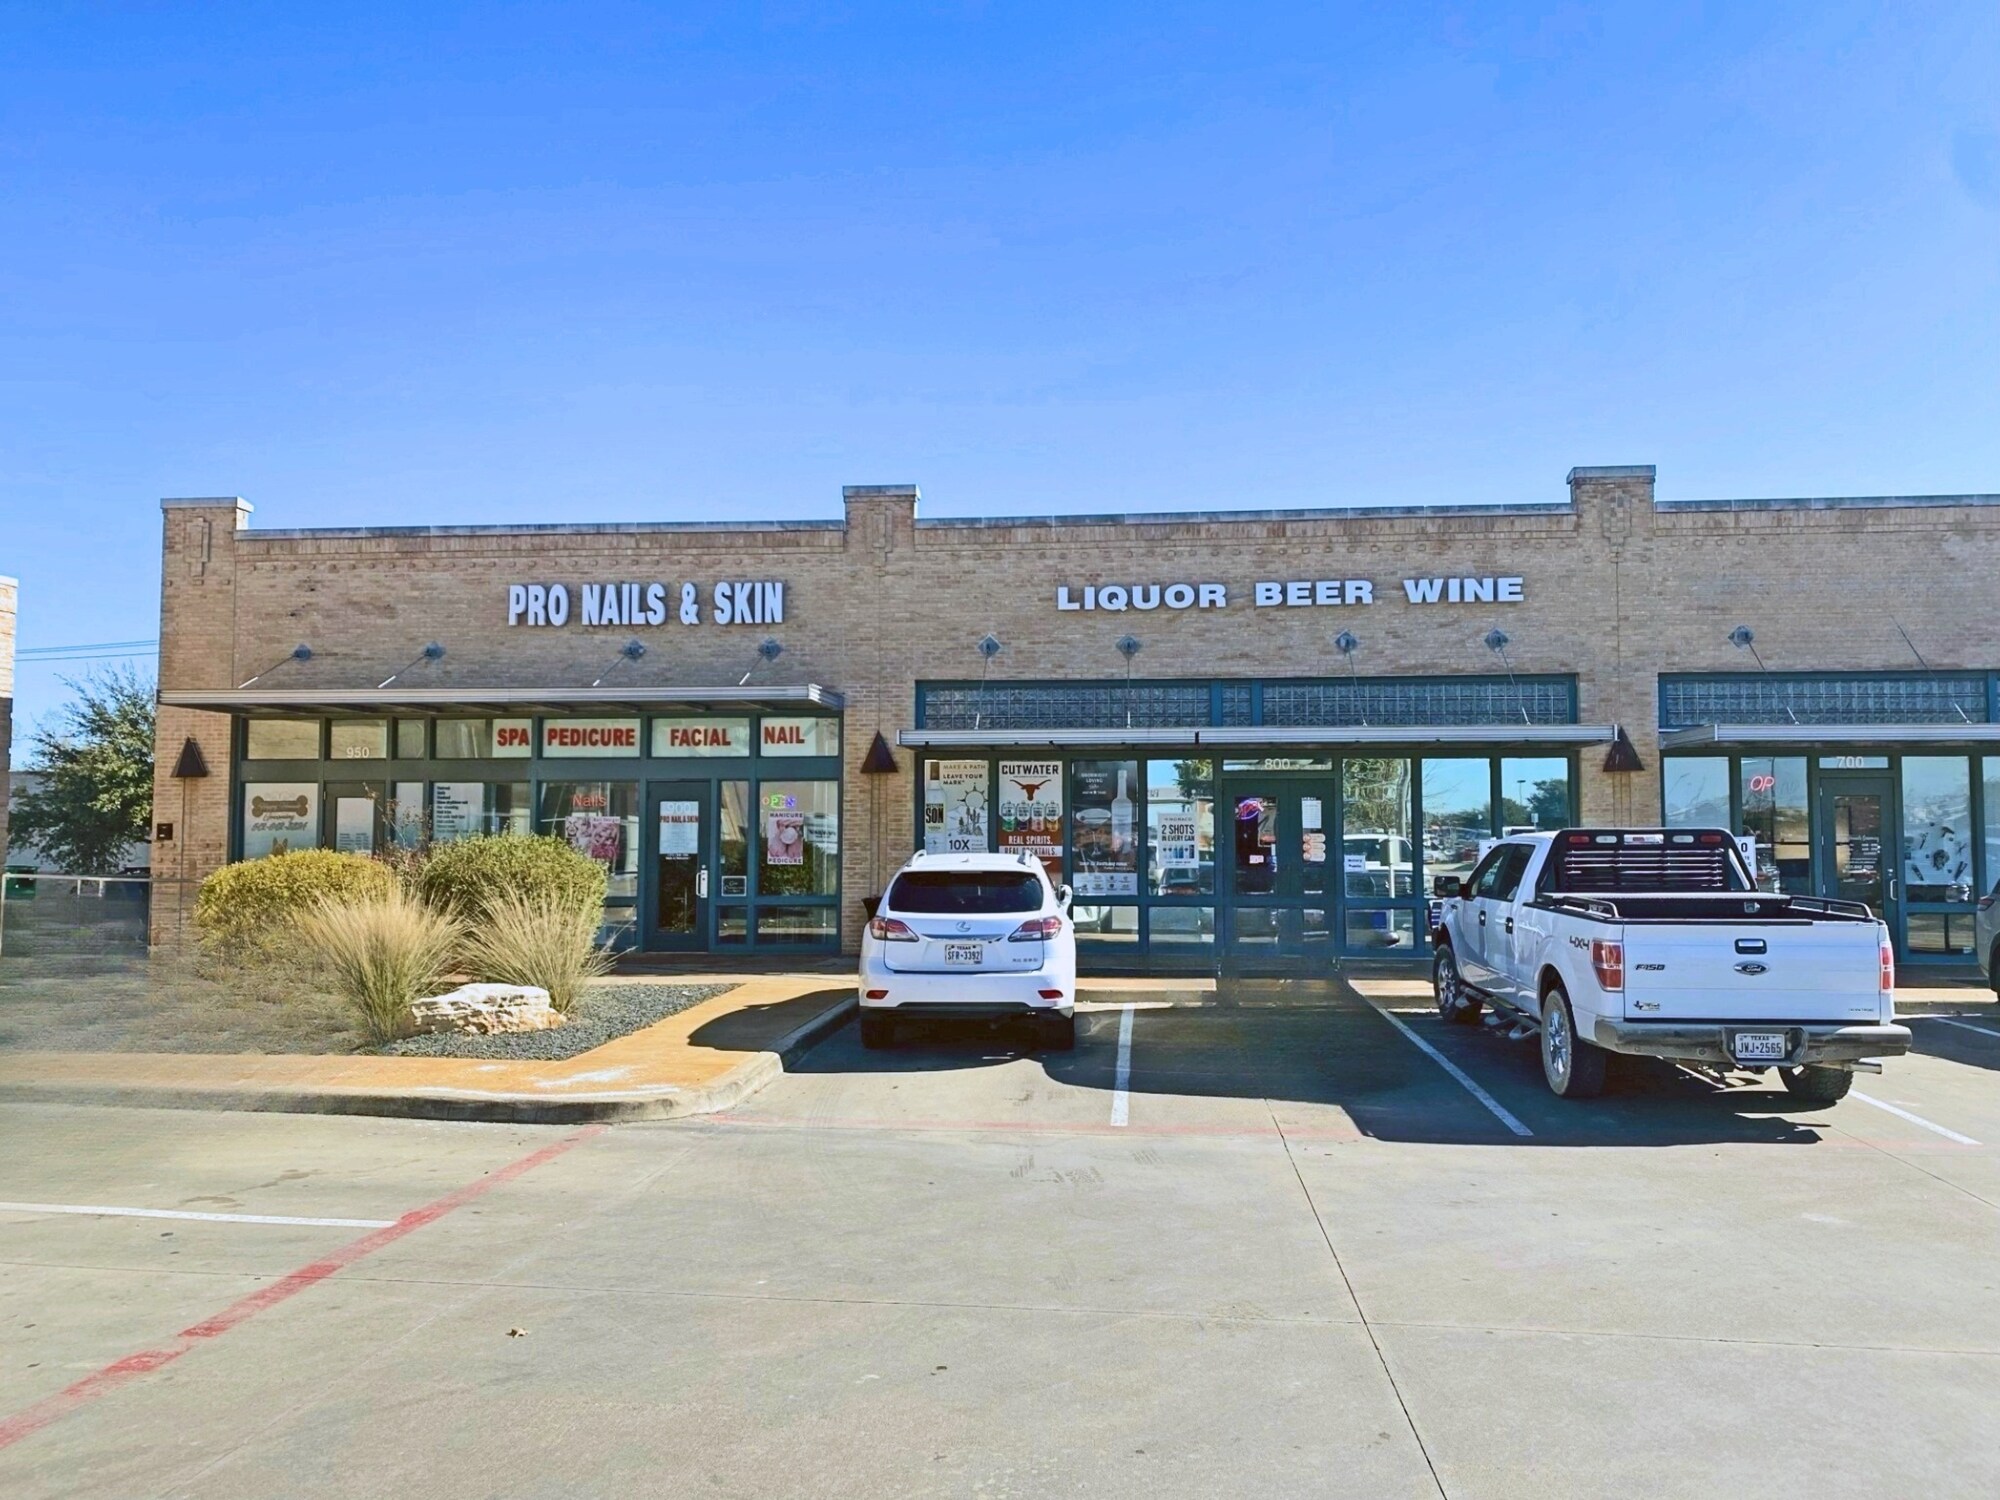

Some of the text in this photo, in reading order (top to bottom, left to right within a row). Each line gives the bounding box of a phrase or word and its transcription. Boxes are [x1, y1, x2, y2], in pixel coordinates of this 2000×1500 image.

[1057, 576, 1525, 612] LIQUOR BEER WINE
[508, 581, 784, 627] PRO NAILS & SKIN
[496, 726, 805, 747] SPA PEDICURE FACIAL NAIL
[346, 746, 370, 758] 950
[1264, 758, 1291, 770] 800
[1836, 756, 1864, 769] 700
[1001, 764, 1059, 775] CUTWATER
[572, 794, 607, 807] Nails
[666, 803, 692, 814] 900
[925, 807, 944, 824] SON
[1161, 824, 1195, 835] 2 SHOTS
[948, 839, 970, 851] 10X
[1008, 835, 1053, 845] REAL SPIRITS.
